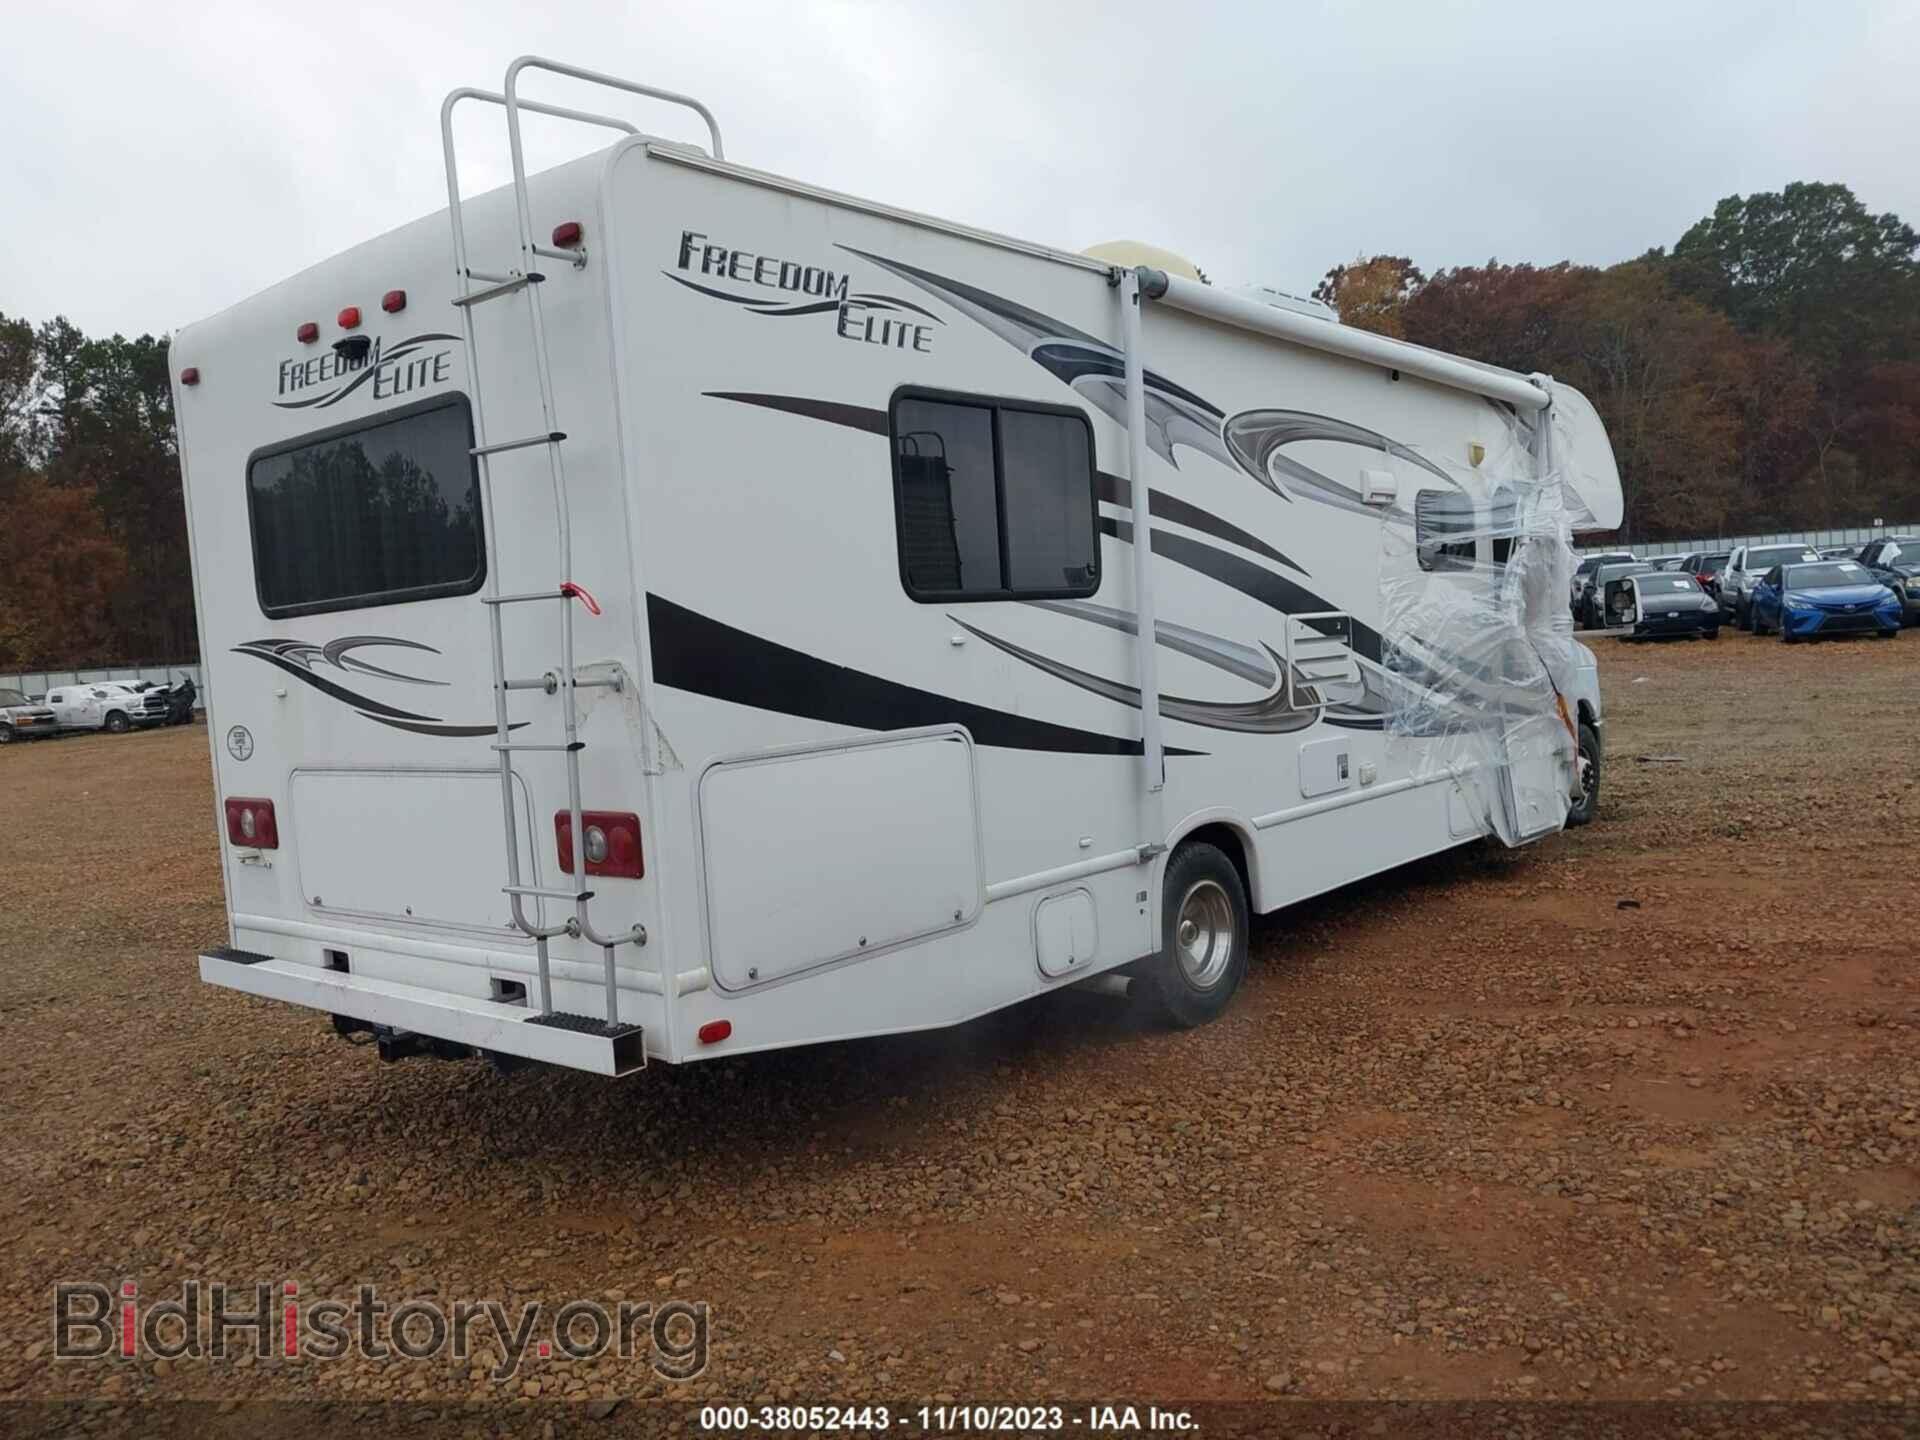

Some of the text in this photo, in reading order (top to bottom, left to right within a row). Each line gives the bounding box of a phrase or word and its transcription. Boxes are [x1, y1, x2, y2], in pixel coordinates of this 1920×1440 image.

[677, 230, 850, 300] FREEDOM
[836, 303, 934, 353] ELITE
[373, 350, 452, 401] ELITE
